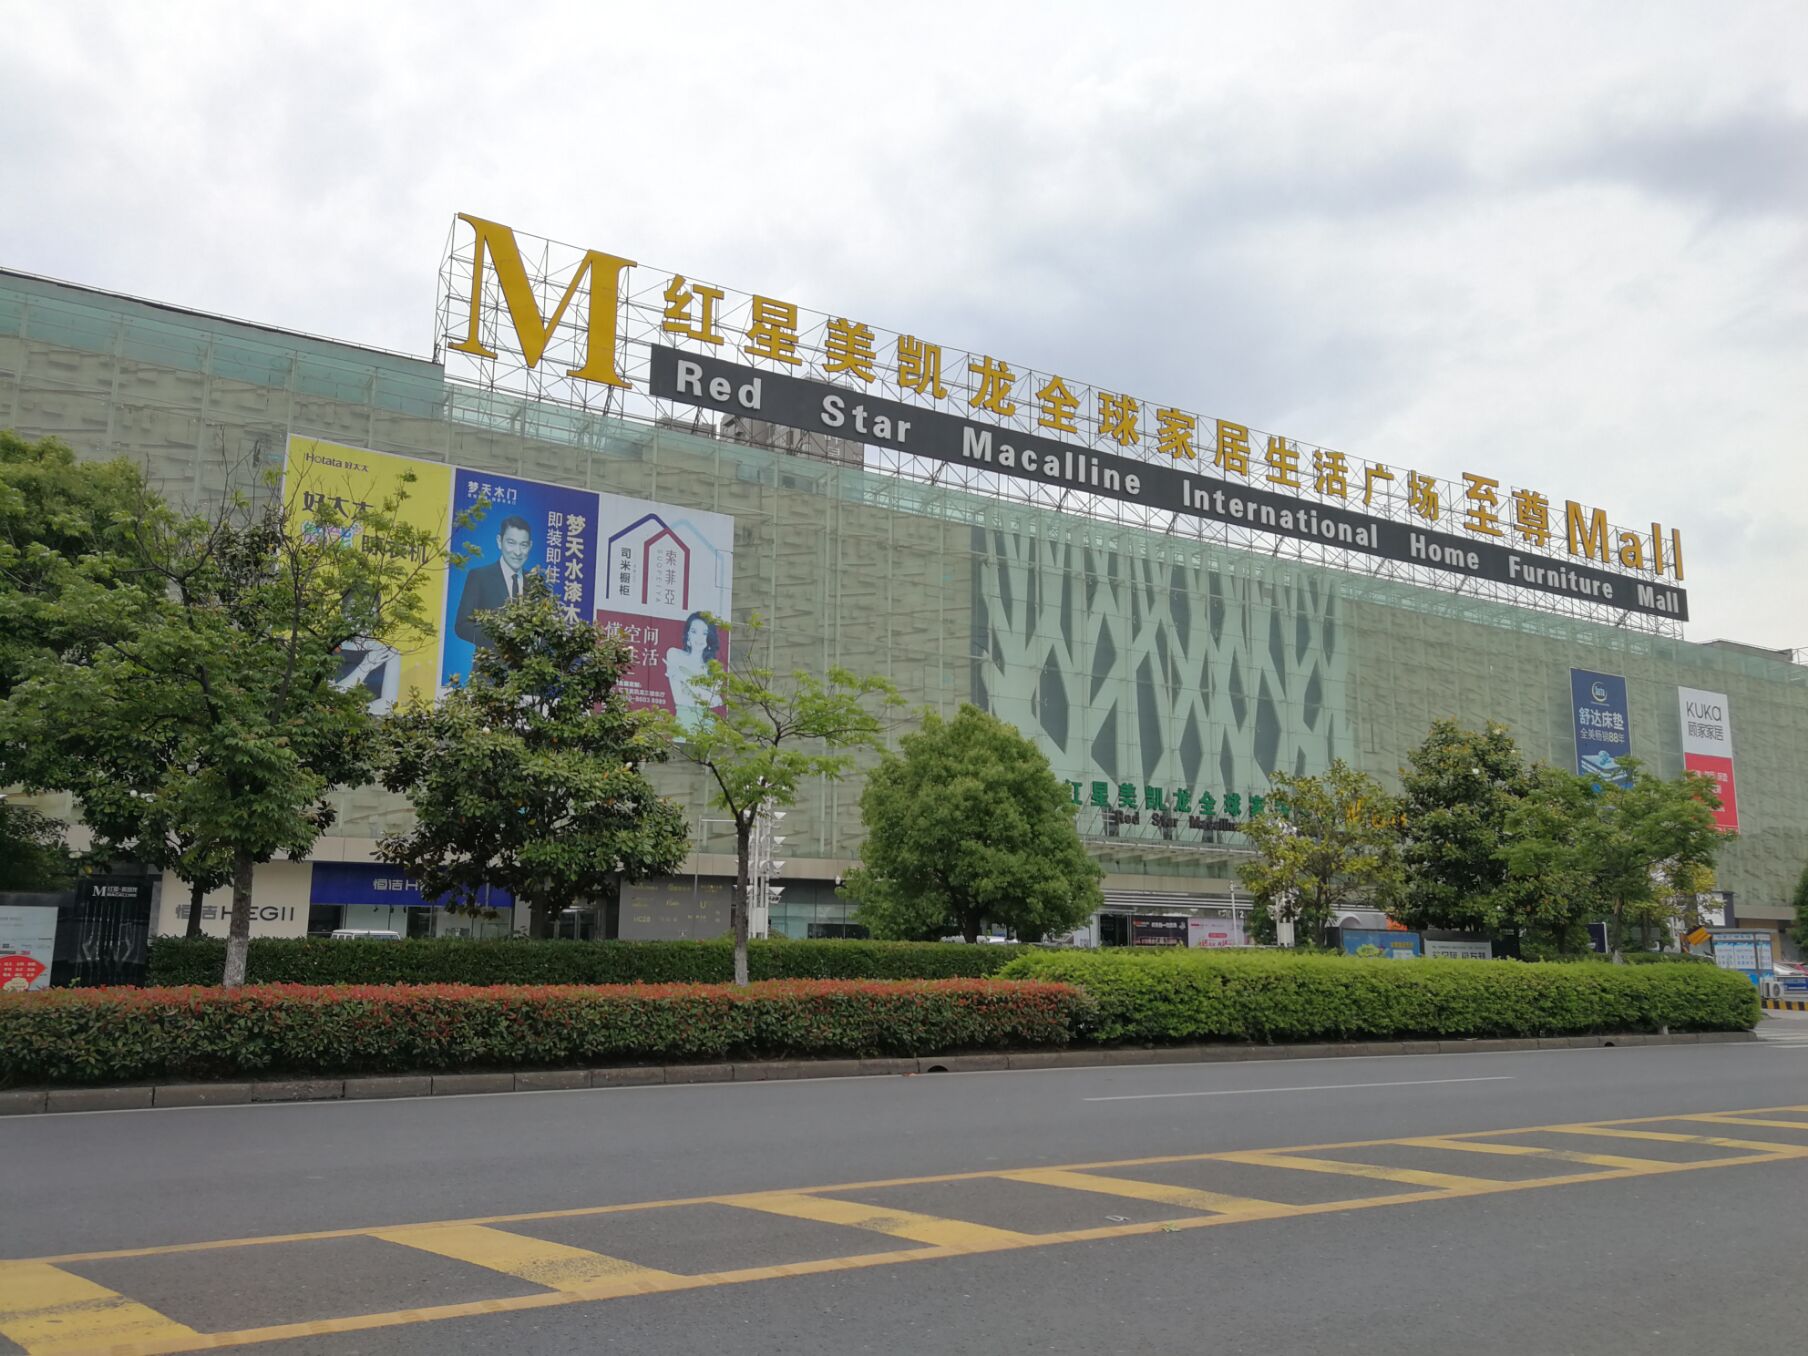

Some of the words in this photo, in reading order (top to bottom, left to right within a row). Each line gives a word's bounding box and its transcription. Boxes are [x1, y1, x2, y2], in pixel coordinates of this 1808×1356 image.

[447, 212, 637, 389] M
[305, 452, 342, 468] Hotata
[467, 481, 517, 501] 梦天木门
[676, 360, 762, 412] Red
[821, 395, 912, 443] Star
[962, 426, 1142, 496] Macalline
[1182, 479, 1378, 549] International
[1410, 533, 1480, 570] Home
[1508, 556, 1614, 600] Furniture
[1637, 585, 1679, 615] Mall
[619, 547, 631, 596] 司米橱柜
[1579, 707, 1624, 730] 舒达床垫
[1688, 721, 1724, 741] 顾家家居
